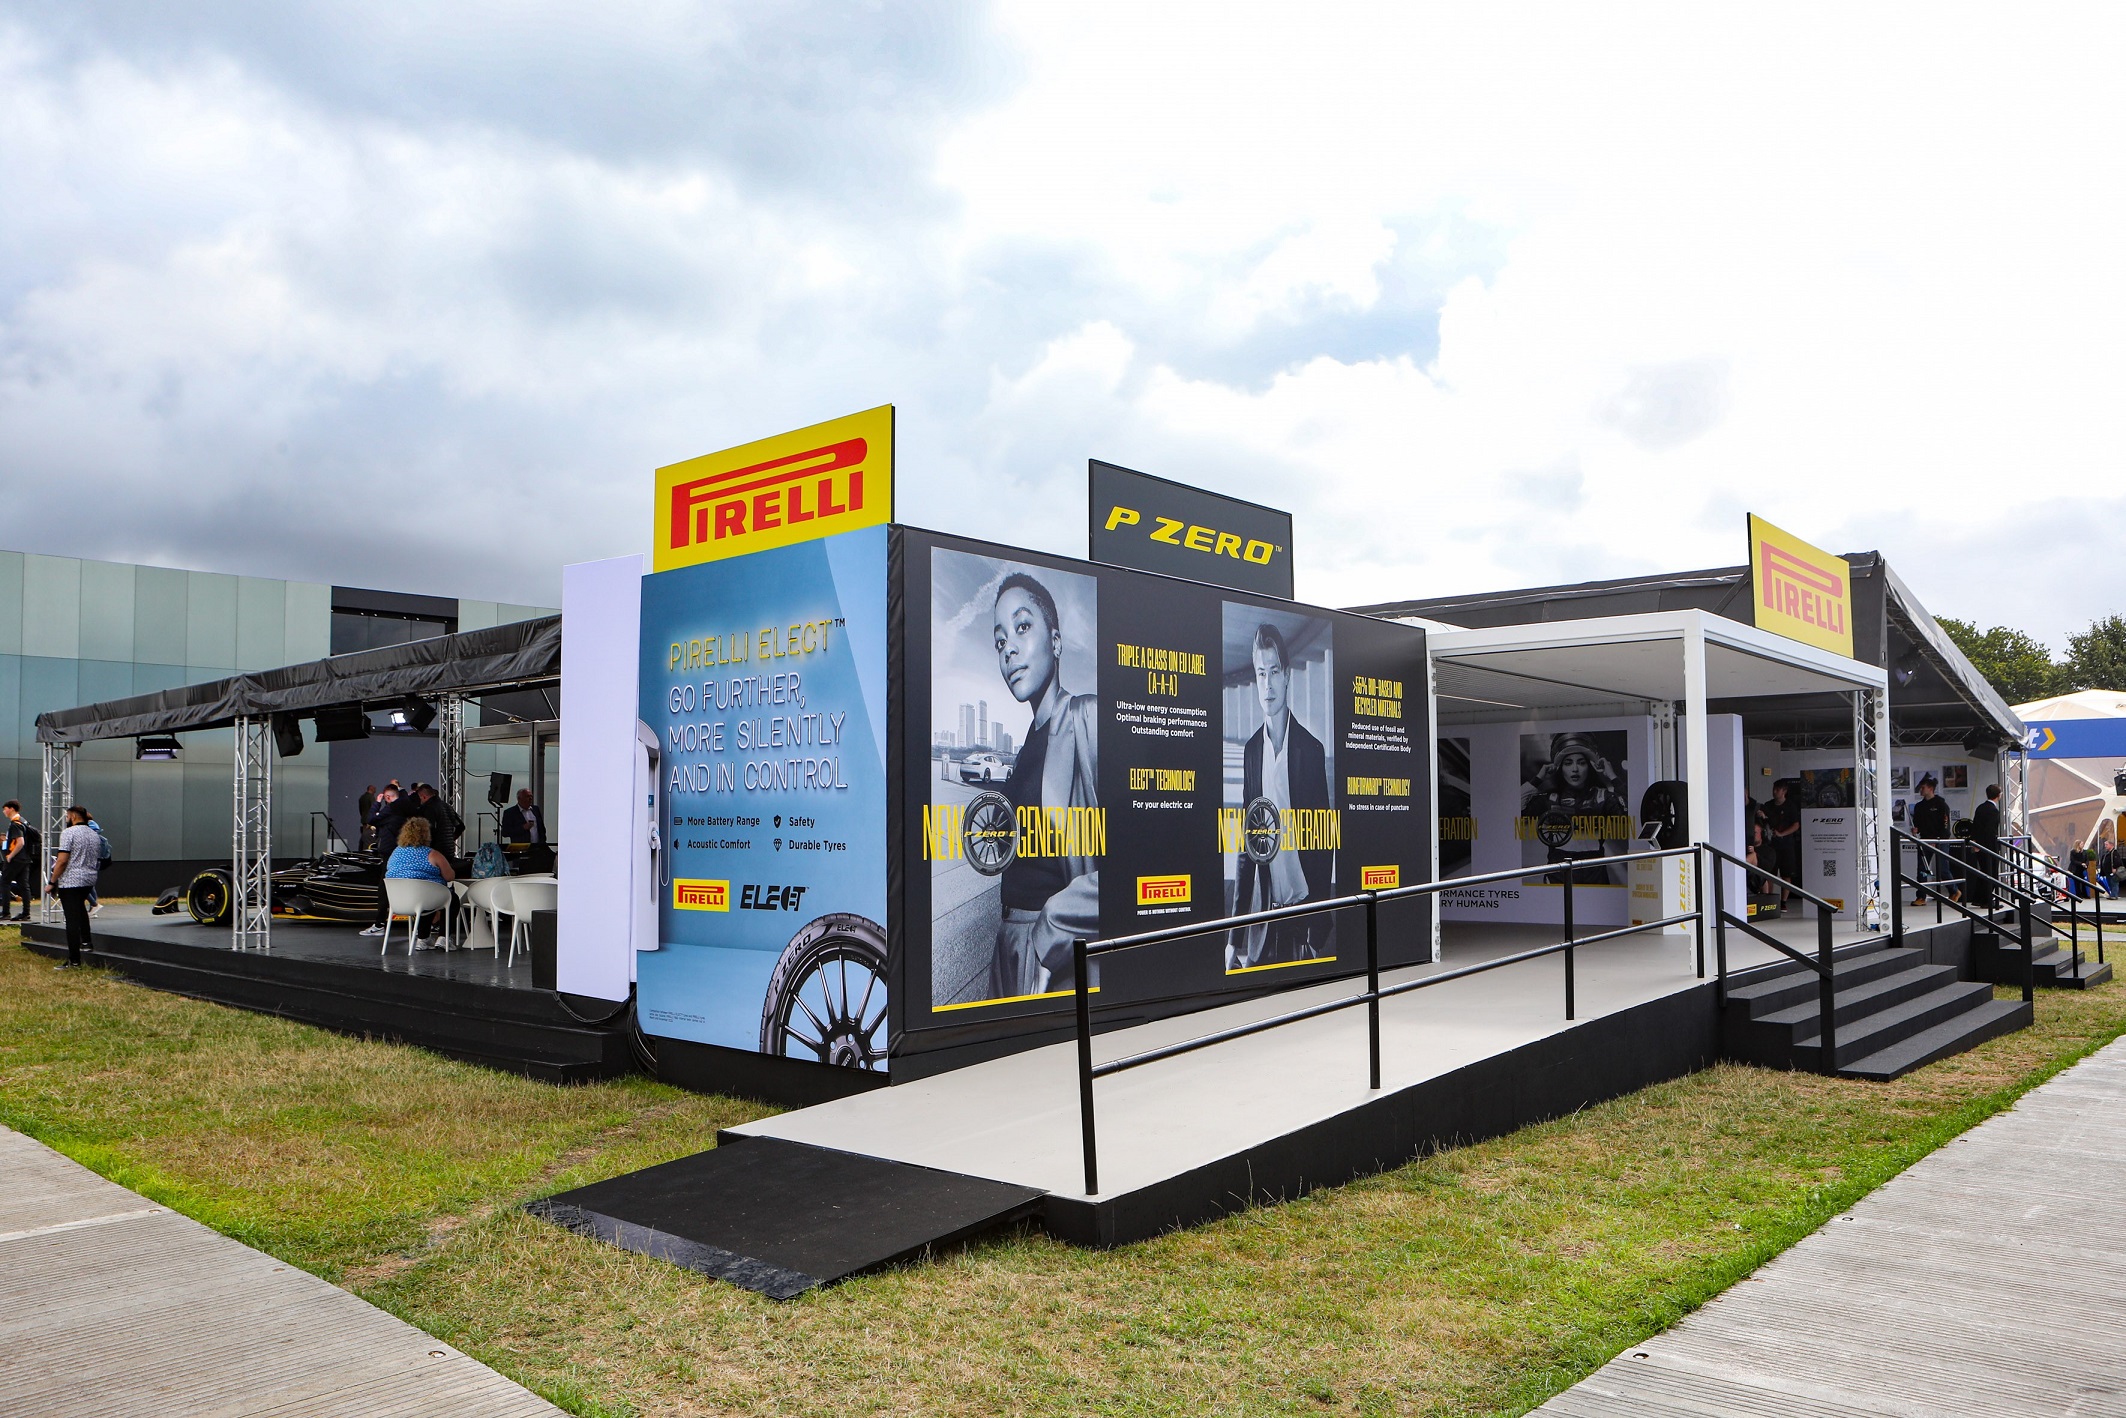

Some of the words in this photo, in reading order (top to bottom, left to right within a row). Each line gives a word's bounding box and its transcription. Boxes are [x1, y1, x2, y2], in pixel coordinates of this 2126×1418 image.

[671, 437, 867, 549] PIRELLI
[1105, 505, 1141, 531] P
[1760, 540, 1844, 635] PIRELLI
[670, 631, 749, 671] PIRELLI
[1117, 643, 1139, 668] TRIPLE
[1141, 647, 1146, 669] A
[1147, 647, 1167, 671] CLASS
[1169, 650, 1178, 672] ON
[1179, 652, 1187, 674] EU
[1188, 653, 1206, 676] LABEL
[669, 684, 695, 714] GO
[702, 672, 806, 710] FURTHER,
[1148, 671, 1178, 697] (A-A-A)
[1116, 700, 1145, 711] Ultra-low
[1146, 705, 1168, 714] energy
[1169, 707, 1207, 717] consumption
[1116, 713, 1141, 722] Optimal
[1143, 715, 1166, 725] braking
[1167, 718, 1207, 728] performances
[1351, 722, 1371, 730] Reduced
[668, 722, 725, 753] MORE
[737, 712, 846, 750] SILENTLY
[1131, 725, 1169, 737] Outstanding
[1170, 729, 1194, 737] comfort
[1386, 735, 1402, 743] verified
[1345, 741, 1373, 750] Independent
[1373, 743, 1400, 752] Certification
[1400, 745, 1412, 753] Body
[668, 763, 710, 793] AND
[716, 762, 735, 792] IN
[744, 757, 848, 790] CONTROL
[1155, 769, 1195, 791] TECHNOLOGY
[1132, 800, 1144, 809] For
[1145, 802, 1159, 810] your
[1160, 801, 1182, 809] electric
[1391, 804, 1409, 812] puncture
[687, 817, 705, 826] More
[707, 816, 734, 827] Battery
[736, 816, 760, 827] Range
[789, 816, 815, 828] Safety
[1218, 808, 1245, 853] NEW
[1280, 808, 1341, 851] GENERATION
[1514, 816, 1539, 840] NEW
[1571, 815, 1636, 840] GENERATION
[923, 804, 965, 860] NEW
[1016, 806, 1106, 858] GENERATION
[964, 830, 973, 838] P
[687, 839, 718, 849] Acoustic
[720, 839, 750, 849] Comfort
[789, 840, 821, 851] Durable
[823, 840, 847, 852] Tyres
[1365, 869, 1396, 885] PIRELLI
[678, 884, 725, 905] PIRELLI
[1142, 880, 1186, 899] PIRELLI
[1488, 890, 1520, 899] TYRES
[1439, 899, 1454, 907] RY
[1456, 900, 1499, 908] HUMANS
[781, 933, 811, 978] ZERO
